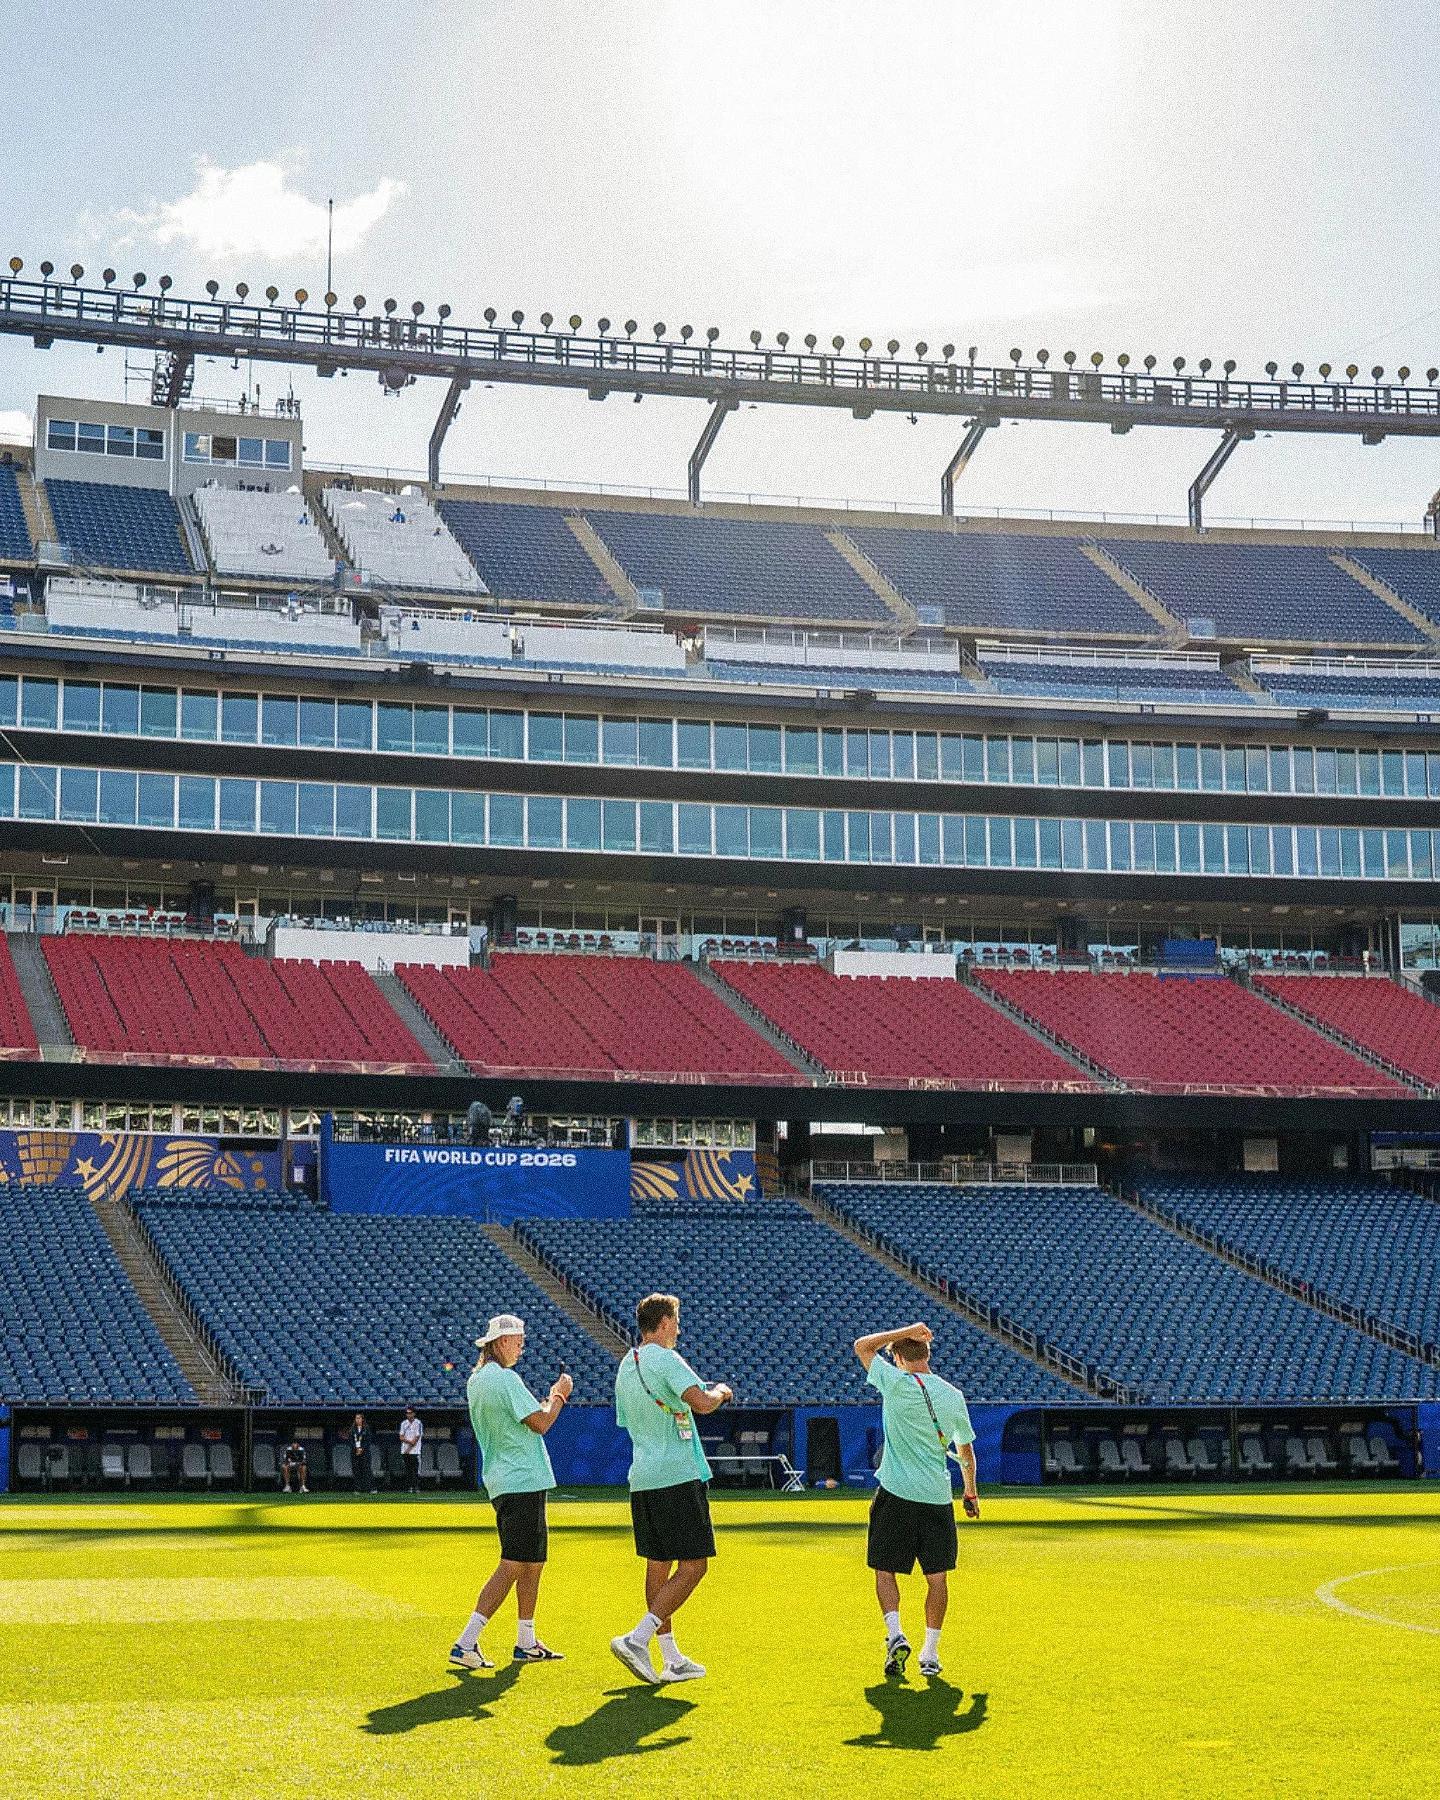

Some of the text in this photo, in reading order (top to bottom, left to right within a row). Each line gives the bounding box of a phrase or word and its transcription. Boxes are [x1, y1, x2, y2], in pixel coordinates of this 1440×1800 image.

[385, 1148, 577, 1167] FIFA WORLD CUP 2026
